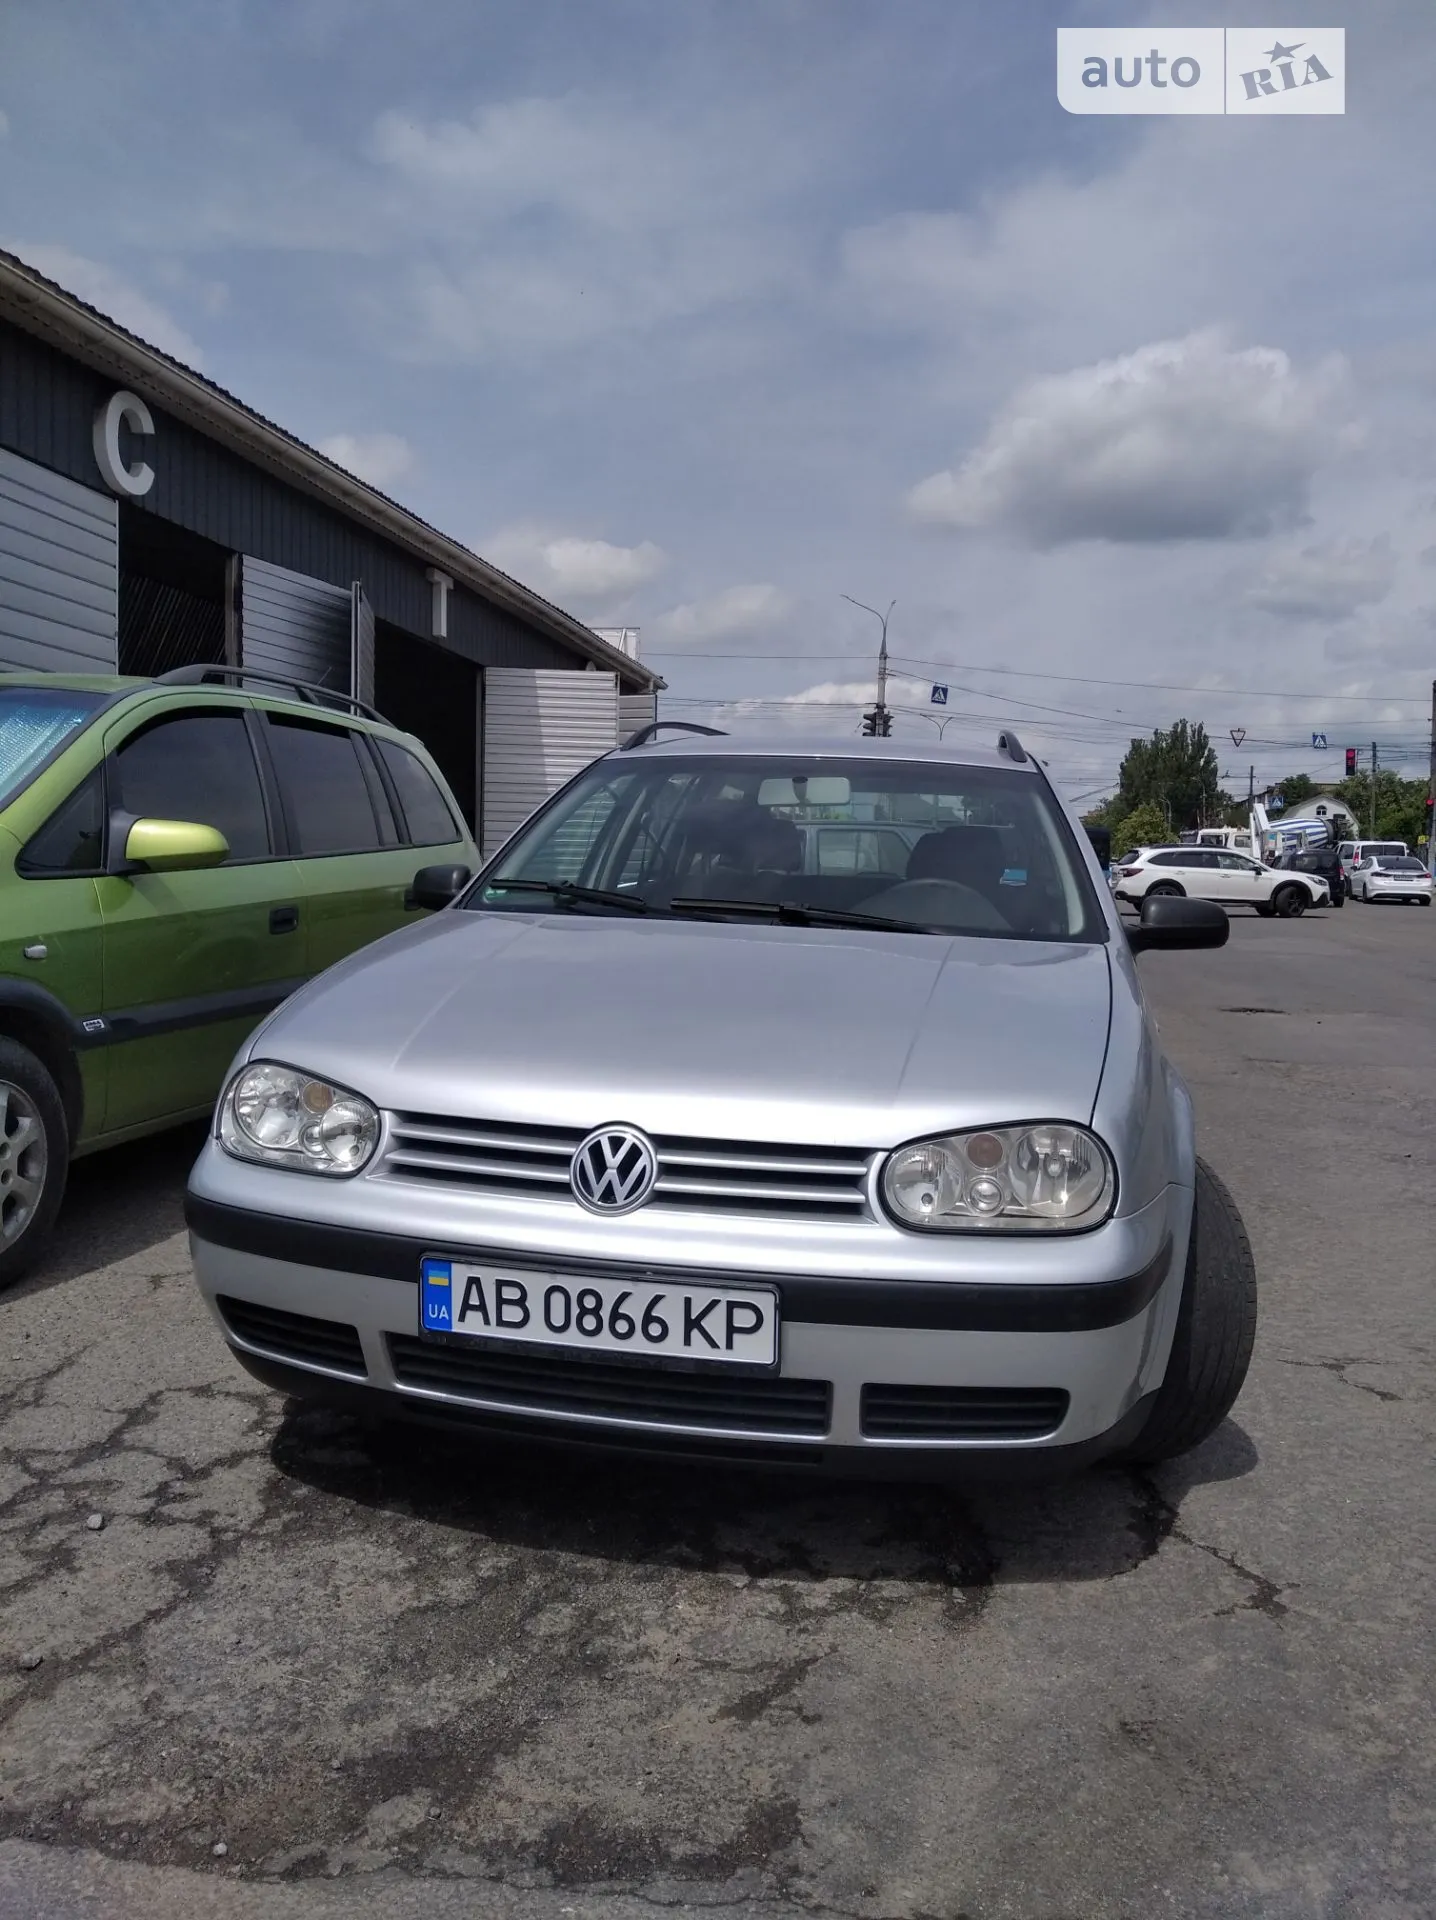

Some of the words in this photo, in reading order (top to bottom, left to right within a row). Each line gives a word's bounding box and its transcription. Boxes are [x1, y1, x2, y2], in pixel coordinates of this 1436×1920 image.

[428, 1303, 450, 1320] UA
[458, 1275, 530, 1329] AB
[544, 1284, 669, 1344] 0866
[683, 1295, 764, 1351] KP
